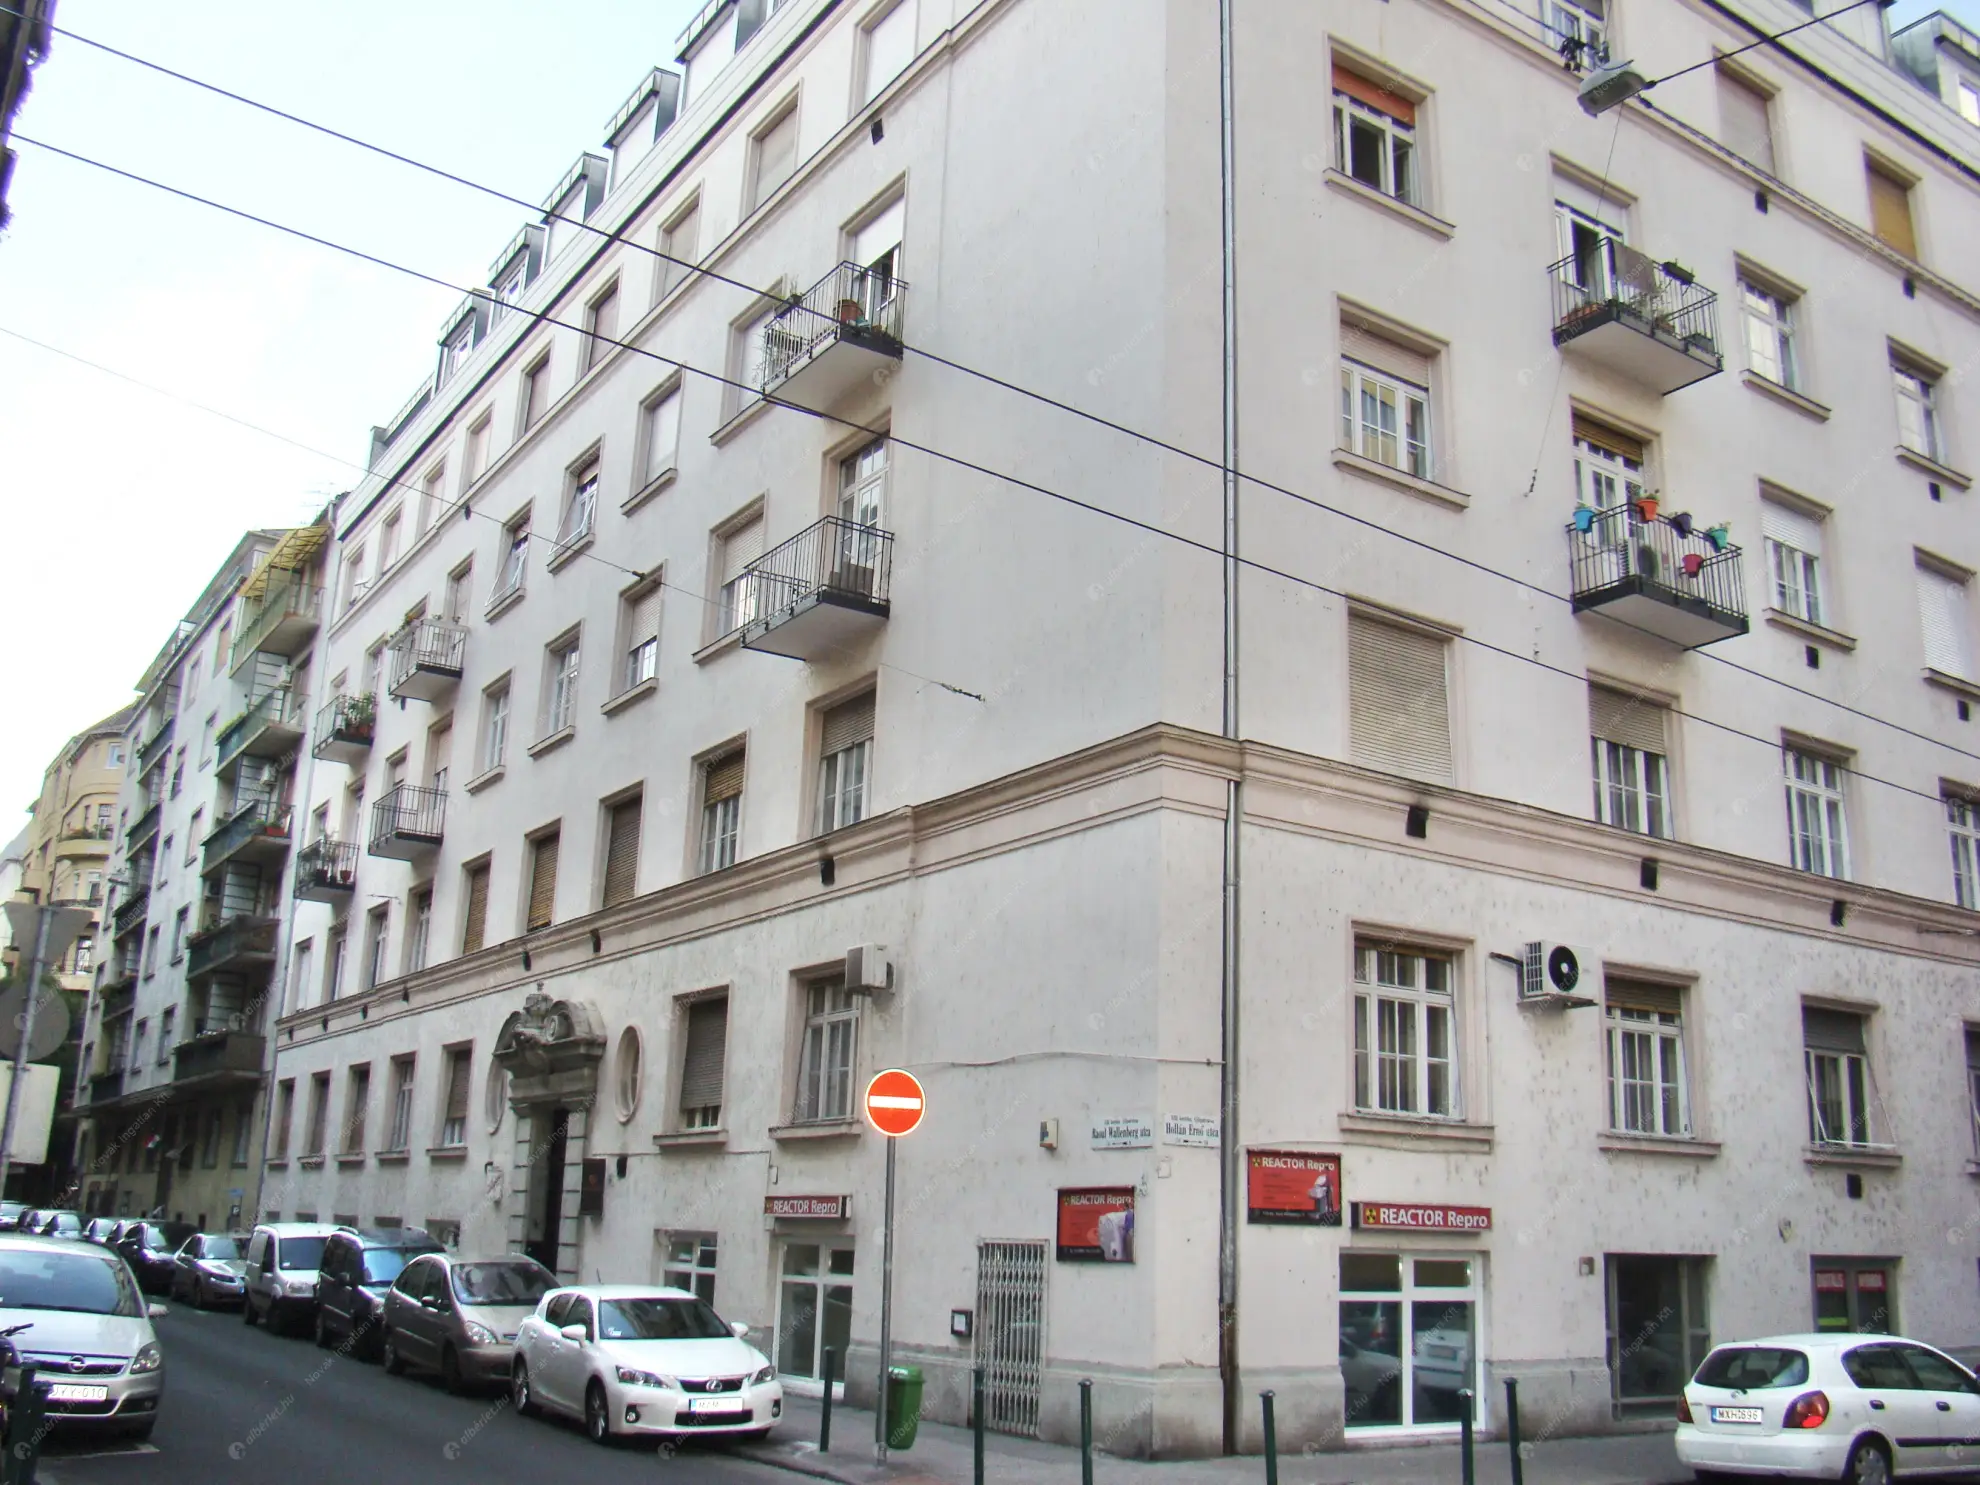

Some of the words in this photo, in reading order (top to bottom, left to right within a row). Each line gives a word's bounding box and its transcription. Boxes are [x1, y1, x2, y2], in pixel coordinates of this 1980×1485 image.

[1092, 1127, 1106, 1139] Raoul
[1108, 1126, 1138, 1139] Wallenberg
[1140, 1127, 1151, 1137] utca
[1206, 1127, 1218, 1138] utca
[1262, 1157, 1305, 1169] REACTOR
[1307, 1160, 1335, 1172] Repro
[773, 1200, 809, 1213] REACTOR
[811, 1201, 837, 1215] Repro
[1070, 1194, 1105, 1206] REACTOR
[1107, 1194, 1132, 1208] Repro
[1380, 1208, 1444, 1226] REACTOR
[1447, 1211, 1488, 1228] Repro
